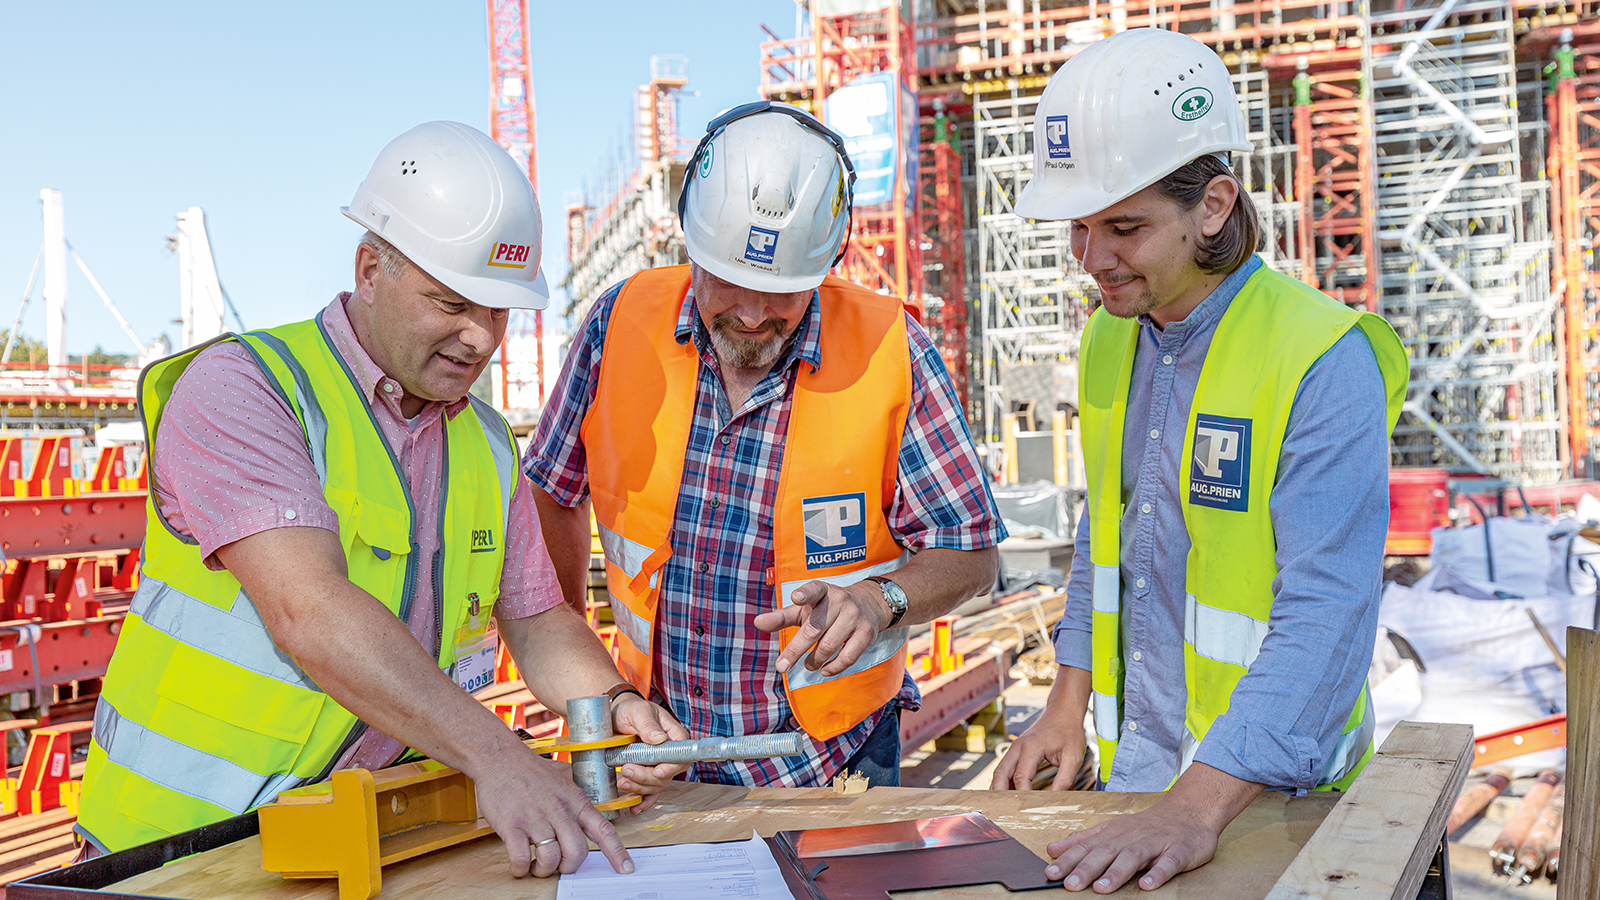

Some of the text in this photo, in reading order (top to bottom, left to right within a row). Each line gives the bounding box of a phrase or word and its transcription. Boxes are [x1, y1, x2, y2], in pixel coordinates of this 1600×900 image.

[495, 243, 530, 262] PERI
[1190, 482, 1241, 499] AUG.PRIEN
[473, 529, 494, 546] PERI
[807, 548, 866, 565] AUG.PRIEN
